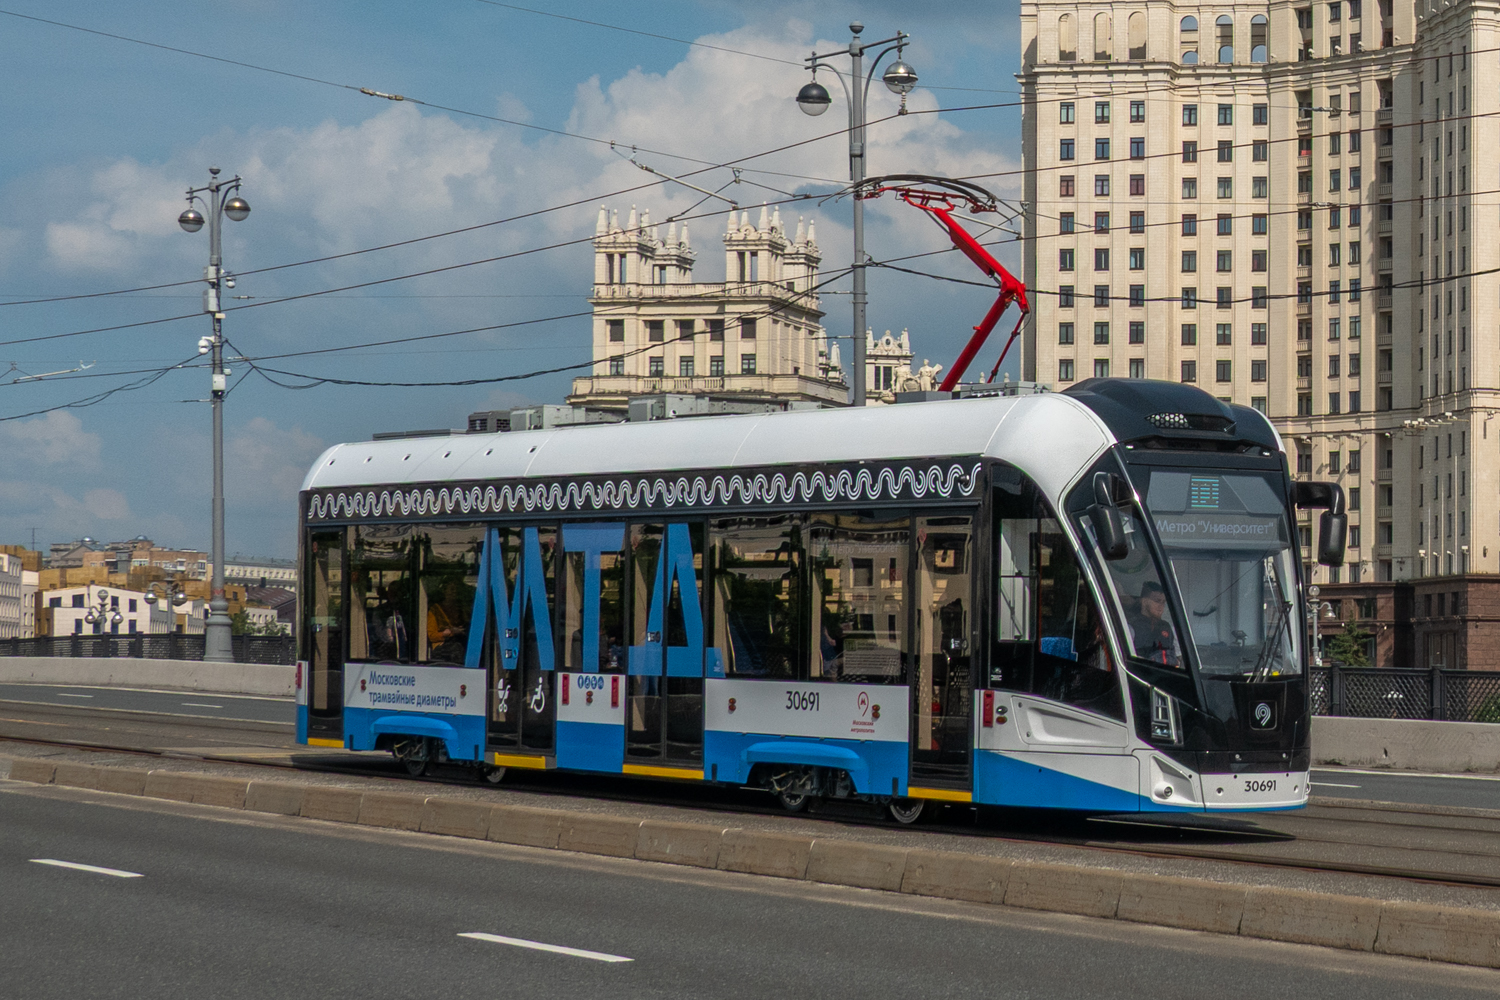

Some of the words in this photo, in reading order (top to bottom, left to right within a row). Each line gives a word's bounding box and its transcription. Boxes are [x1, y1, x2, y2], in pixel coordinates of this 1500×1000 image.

[1156, 520, 1196, 535] Метро
[1197, 520, 1274, 536] "Университет"
[464, 522, 726, 678] МТД
[369, 670, 416, 687] Московские
[369, 690, 415, 706] трамвайные
[416, 695, 457, 710] диаметры
[785, 690, 820, 712] 30691
[1244, 779, 1277, 792] 30691
